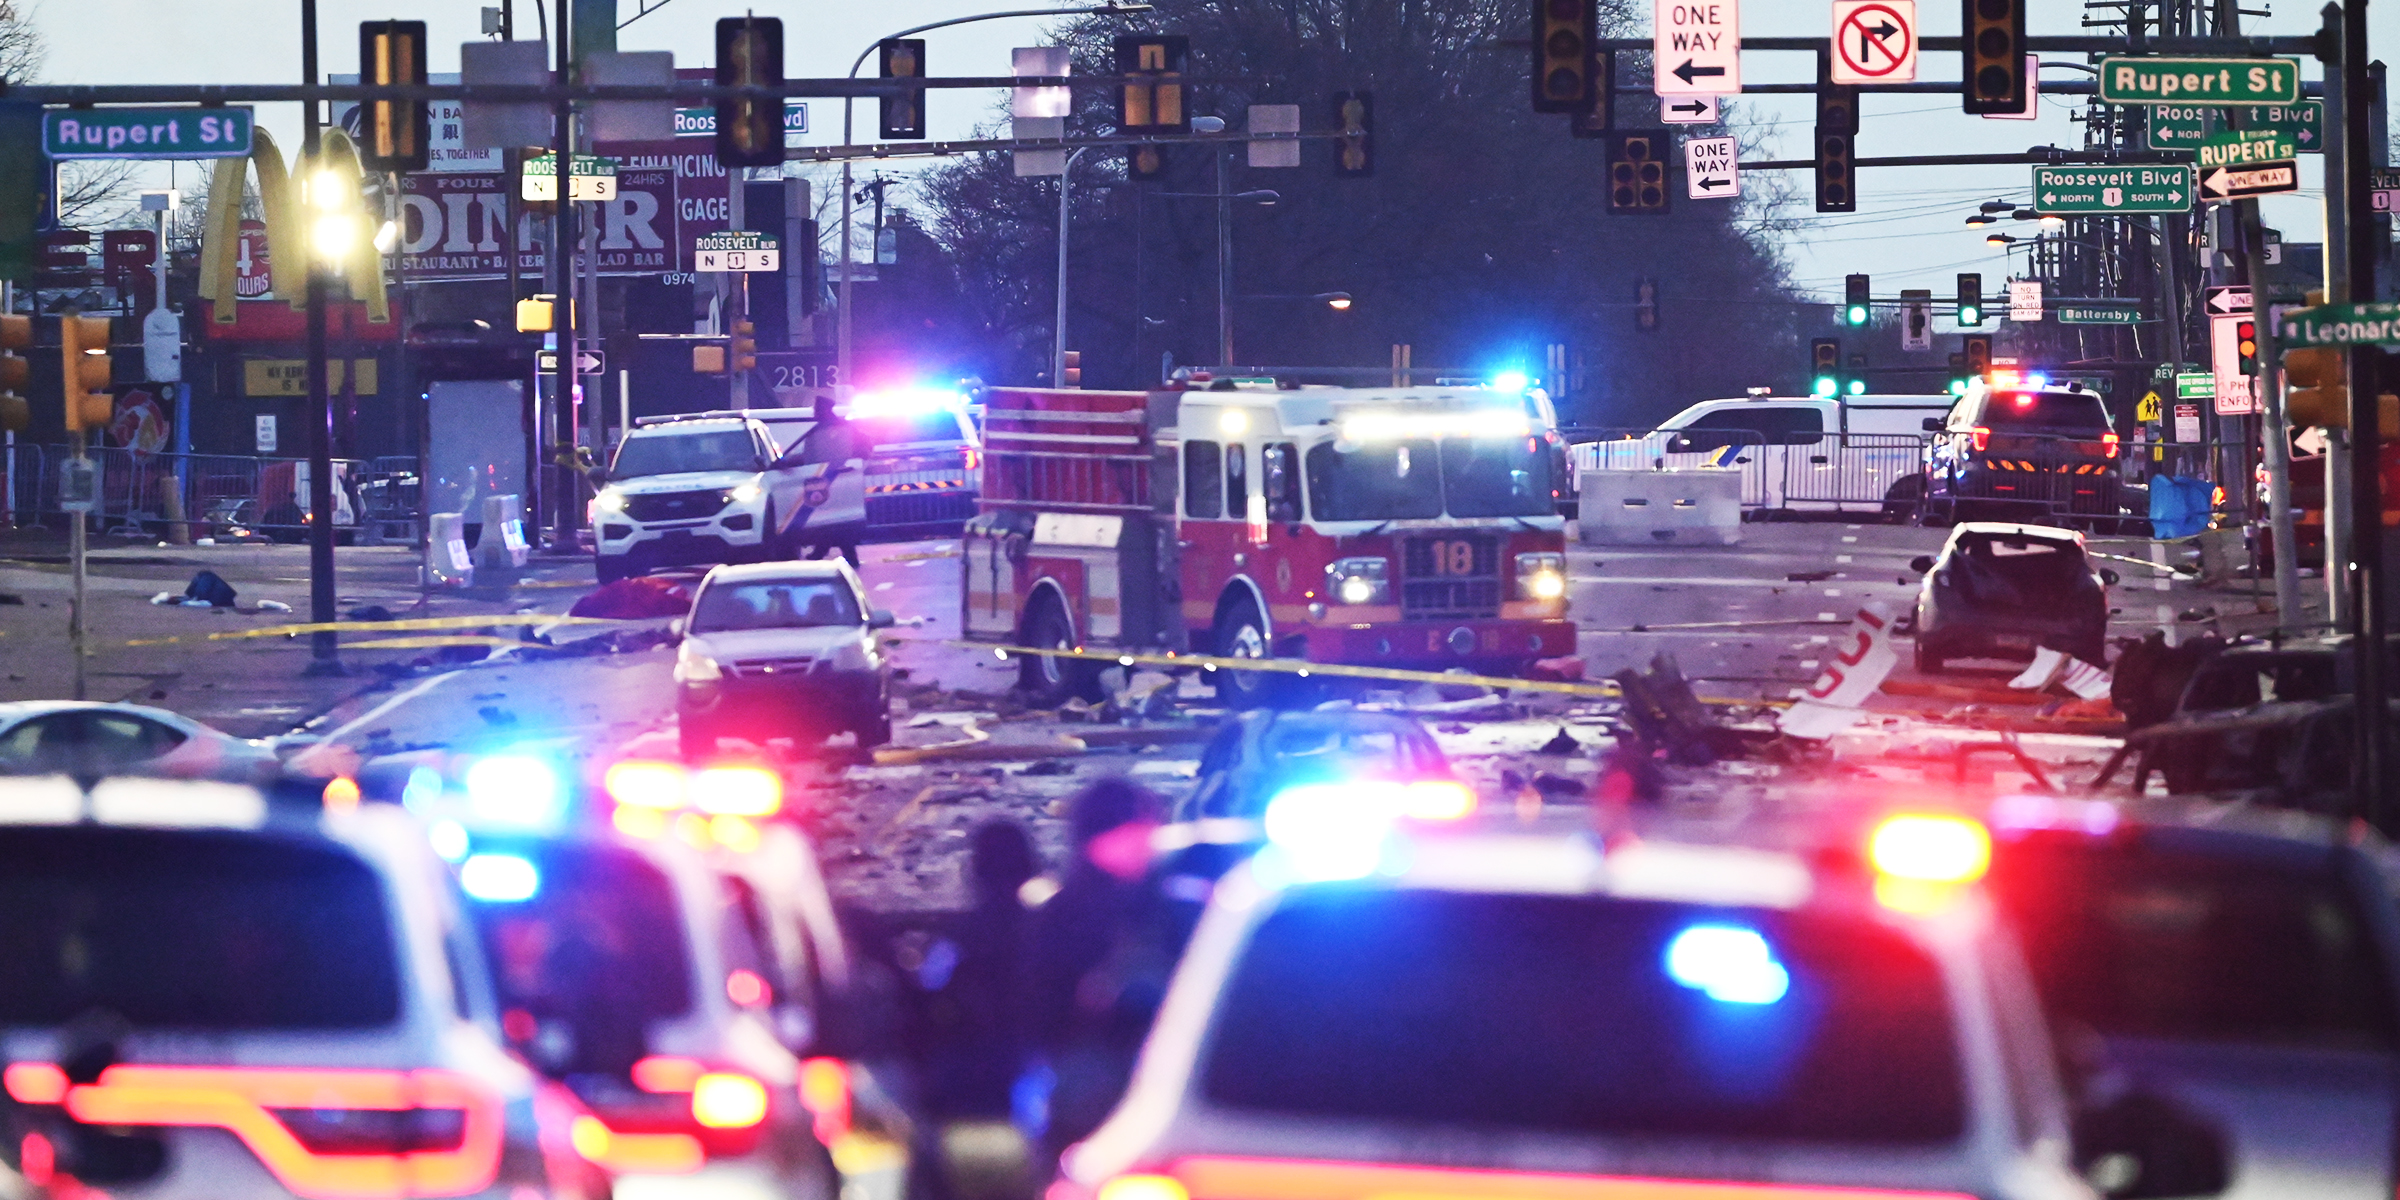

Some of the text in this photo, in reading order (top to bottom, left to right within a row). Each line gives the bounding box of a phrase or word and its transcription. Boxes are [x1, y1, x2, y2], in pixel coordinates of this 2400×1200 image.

[1673, 5, 1721, 25] ONE
[1672, 32, 1721, 51] WAY
[2115, 66, 2283, 96] Rupert St
[2269, 107, 2314, 122] Blvd
[59, 116, 236, 150] Rupert St
[447, 149, 490, 160] TOGETHER
[1695, 143, 1728, 157] ONE
[2201, 140, 2276, 165] RUPERT
[523, 160, 593, 175] ROOSELT
[1695, 159, 1729, 173] WAY
[437, 178, 495, 189] FOUR
[625, 173, 665, 185] 24HRS
[2041, 171, 2182, 186] Roosevelt Blvd
[2228, 171, 2286, 187] ONE WAY
[596, 181, 605, 194] S
[2061, 191, 2164, 203] NORTH 1 SOUTH
[681, 197, 728, 221] GAGE
[379, 187, 664, 254] DINR
[696, 237, 776, 250] ROOSEVELT BLVD
[382, 256, 480, 270] RSTAURANT
[577, 253, 626, 267] SLAD
[633, 253, 665, 266] BAR
[705, 255, 770, 266] N 1 S
[237, 273, 269, 295] OURS
[663, 273, 695, 285] 0974
[2230, 295, 2254, 305] ONE
[2066, 309, 2130, 321] Battersby
[2305, 318, 2400, 343] Leonar
[774, 365, 840, 388] 2813
[1433, 541, 1474, 576] 18
